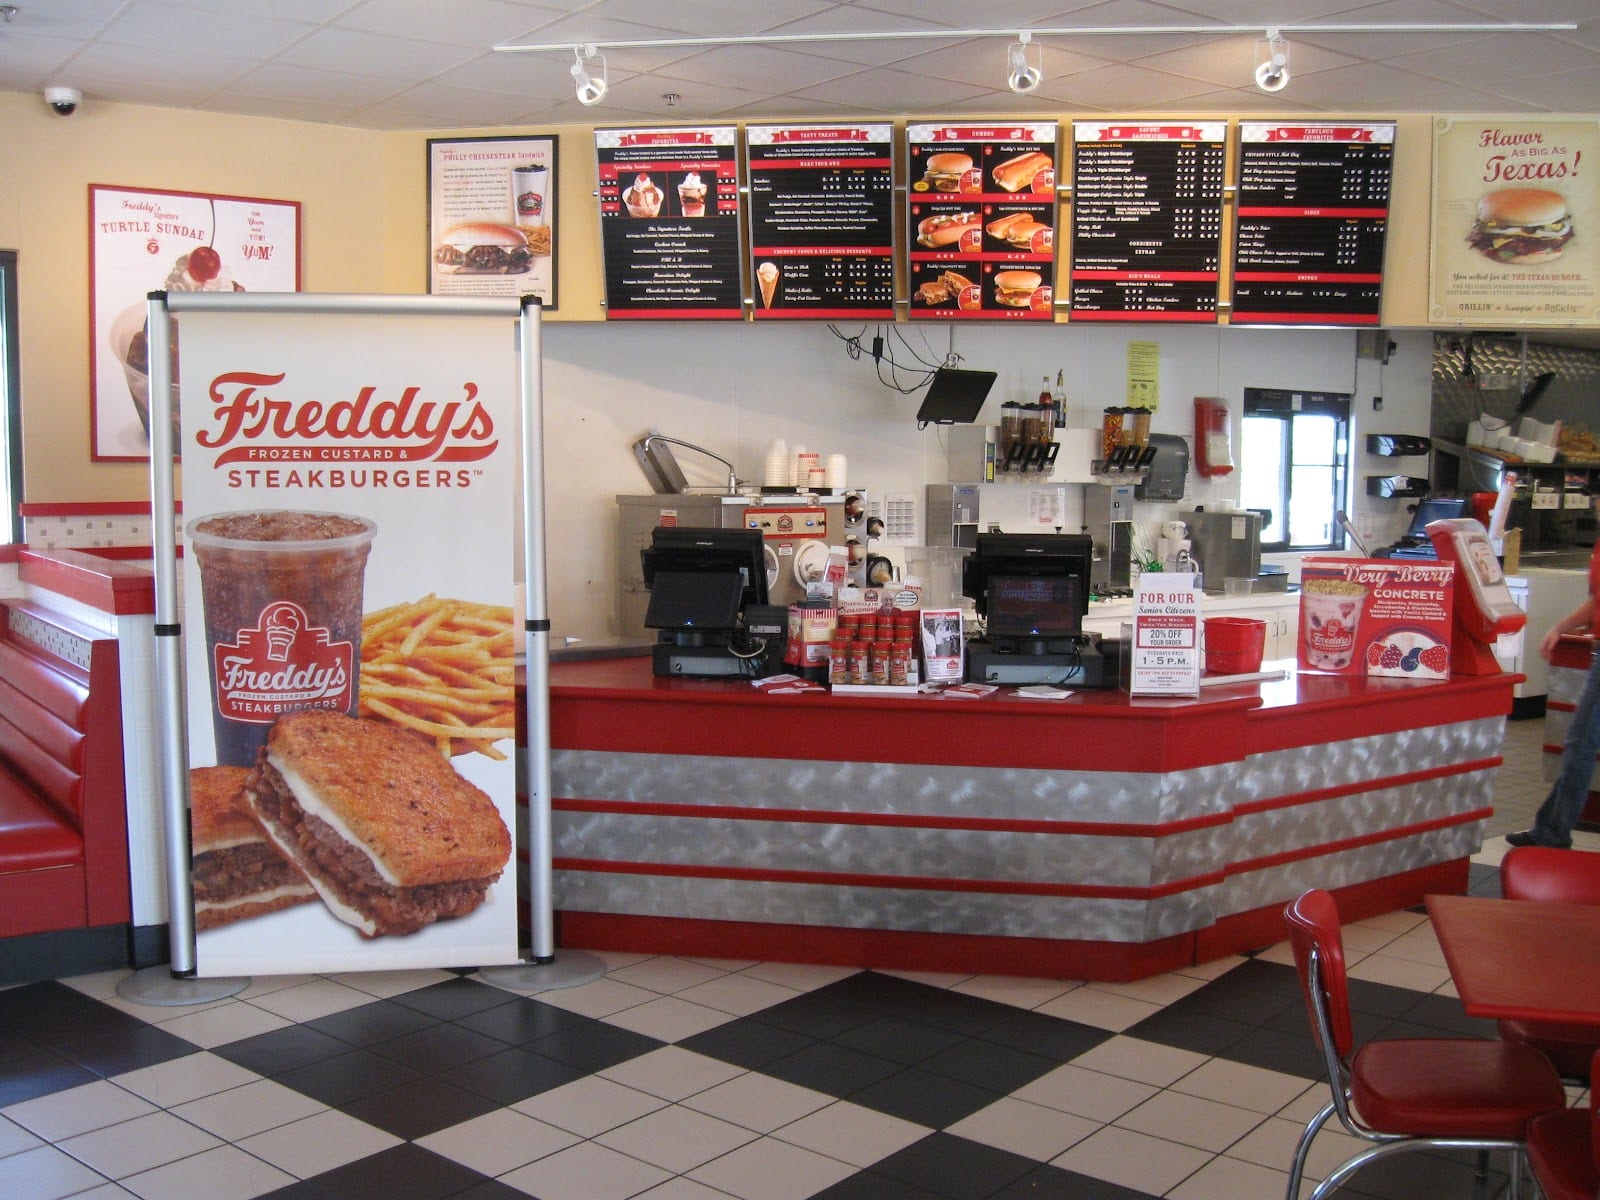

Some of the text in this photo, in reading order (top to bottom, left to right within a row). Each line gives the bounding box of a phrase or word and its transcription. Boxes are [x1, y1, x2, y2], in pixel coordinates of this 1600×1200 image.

[1479, 128, 1544, 147] Flavor
[1483, 151, 1581, 182] Texas!
[121, 200, 161, 212] Freddy's
[101, 222, 205, 240] TURTLE SUNDAE
[196, 372, 495, 450] Freddy's
[249, 450, 408, 459] FROZEN CUSTARD &
[1343, 566, 1453, 589] Very Berry
[1140, 593, 1194, 604] FOR OUR
[1373, 589, 1445, 600] CONCRETE
[1138, 606, 1195, 614] Senior Citizens
[1150, 630, 1182, 638] 20% OFF
[221, 656, 347, 692] Freddy's
